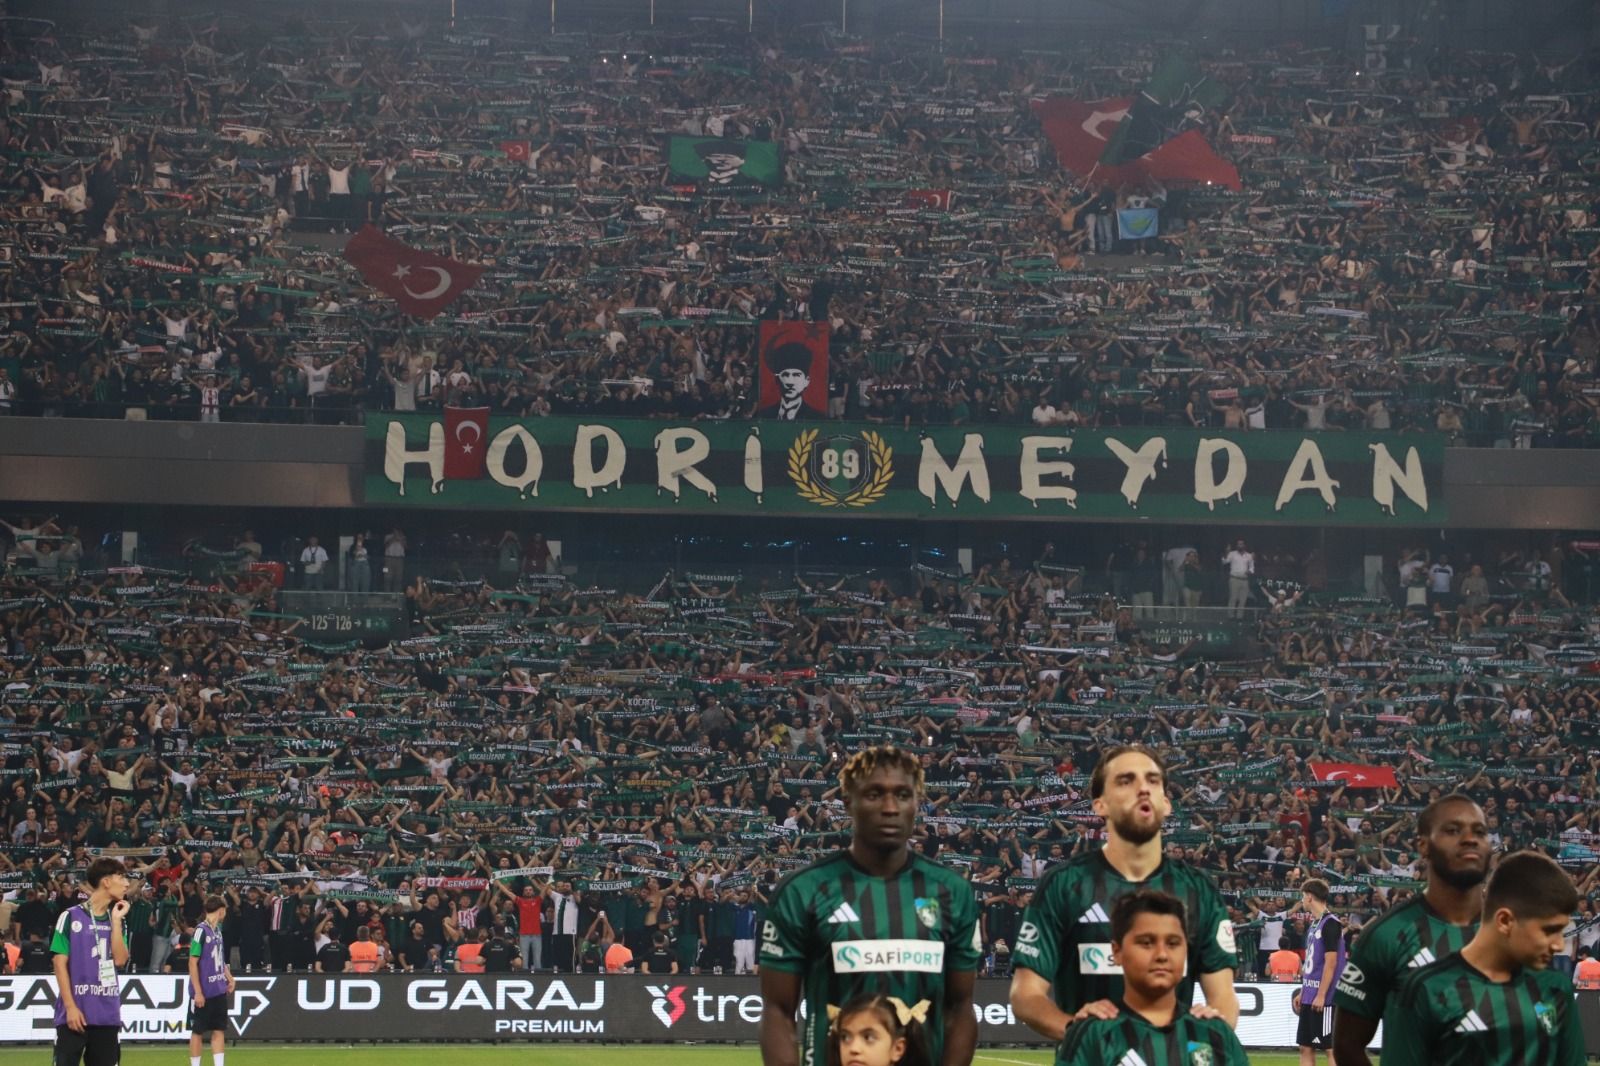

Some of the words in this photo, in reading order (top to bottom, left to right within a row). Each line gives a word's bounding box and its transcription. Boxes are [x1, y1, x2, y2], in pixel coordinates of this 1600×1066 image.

[820, 448, 861, 480] 89
[918, 433, 1429, 517] MEYDAN
[312, 615, 327, 630] 125
[336, 615, 352, 630] 126
[864, 948, 942, 967] SAFİPORT
[75, 984, 89, 996] TOP
[298, 980, 381, 1011] UD
[408, 980, 605, 1011] GARAJ
[495, 1020, 605, 1034] PREMIUM
